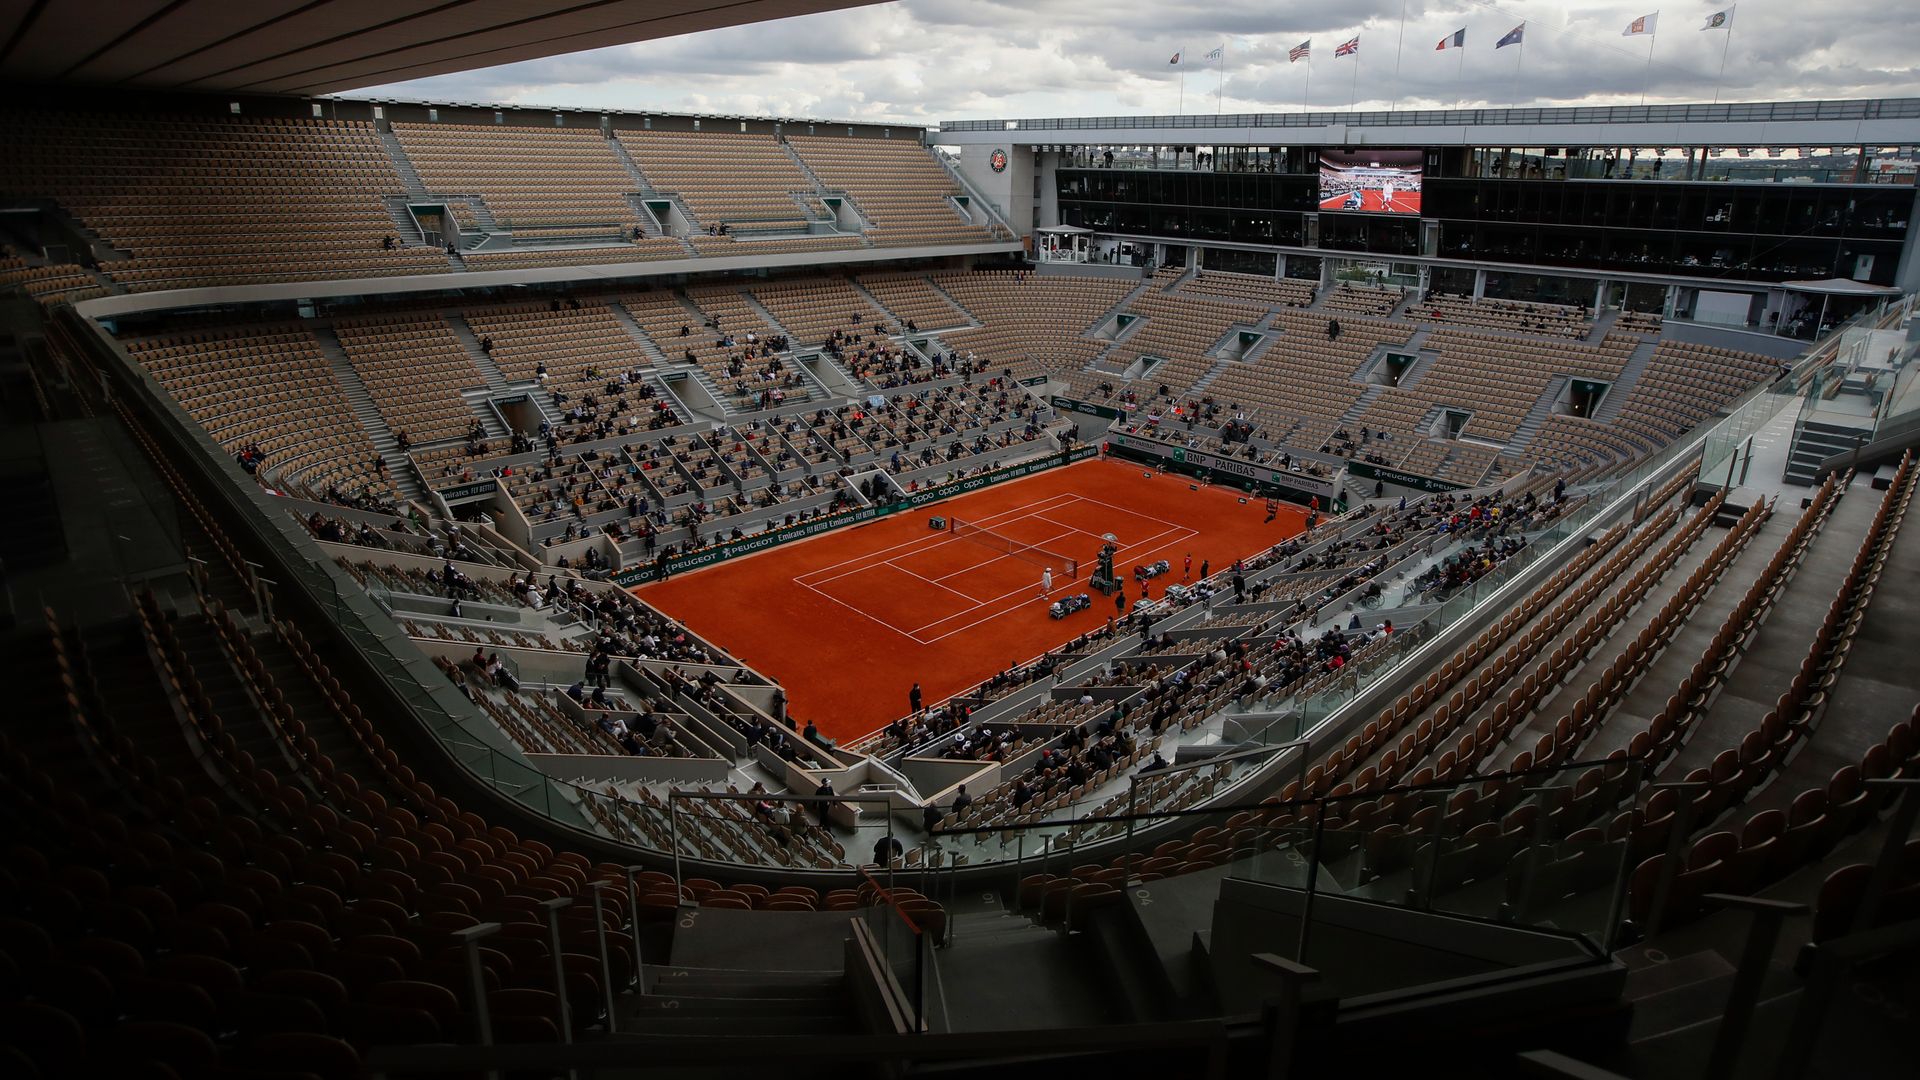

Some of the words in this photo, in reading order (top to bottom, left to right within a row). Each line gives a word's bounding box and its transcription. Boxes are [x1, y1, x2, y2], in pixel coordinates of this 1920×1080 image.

[1187, 453, 1206, 465] BNP
[1215, 459, 1256, 476] PARIBAS
[963, 478, 984, 489] oppo
[1381, 471, 1418, 484] PEUGEOT
[938, 485, 960, 496] oppo
[1294, 479, 1319, 490] PARIBAS
[443, 489, 469, 500] mirates
[911, 492, 934, 504] oppo
[829, 515, 855, 528] Emirates
[777, 528, 806, 542] Emirates
[731, 537, 774, 555] PEUGEOT
[671, 552, 717, 571] PEUGEOT
[680, 911, 699, 928] 04
